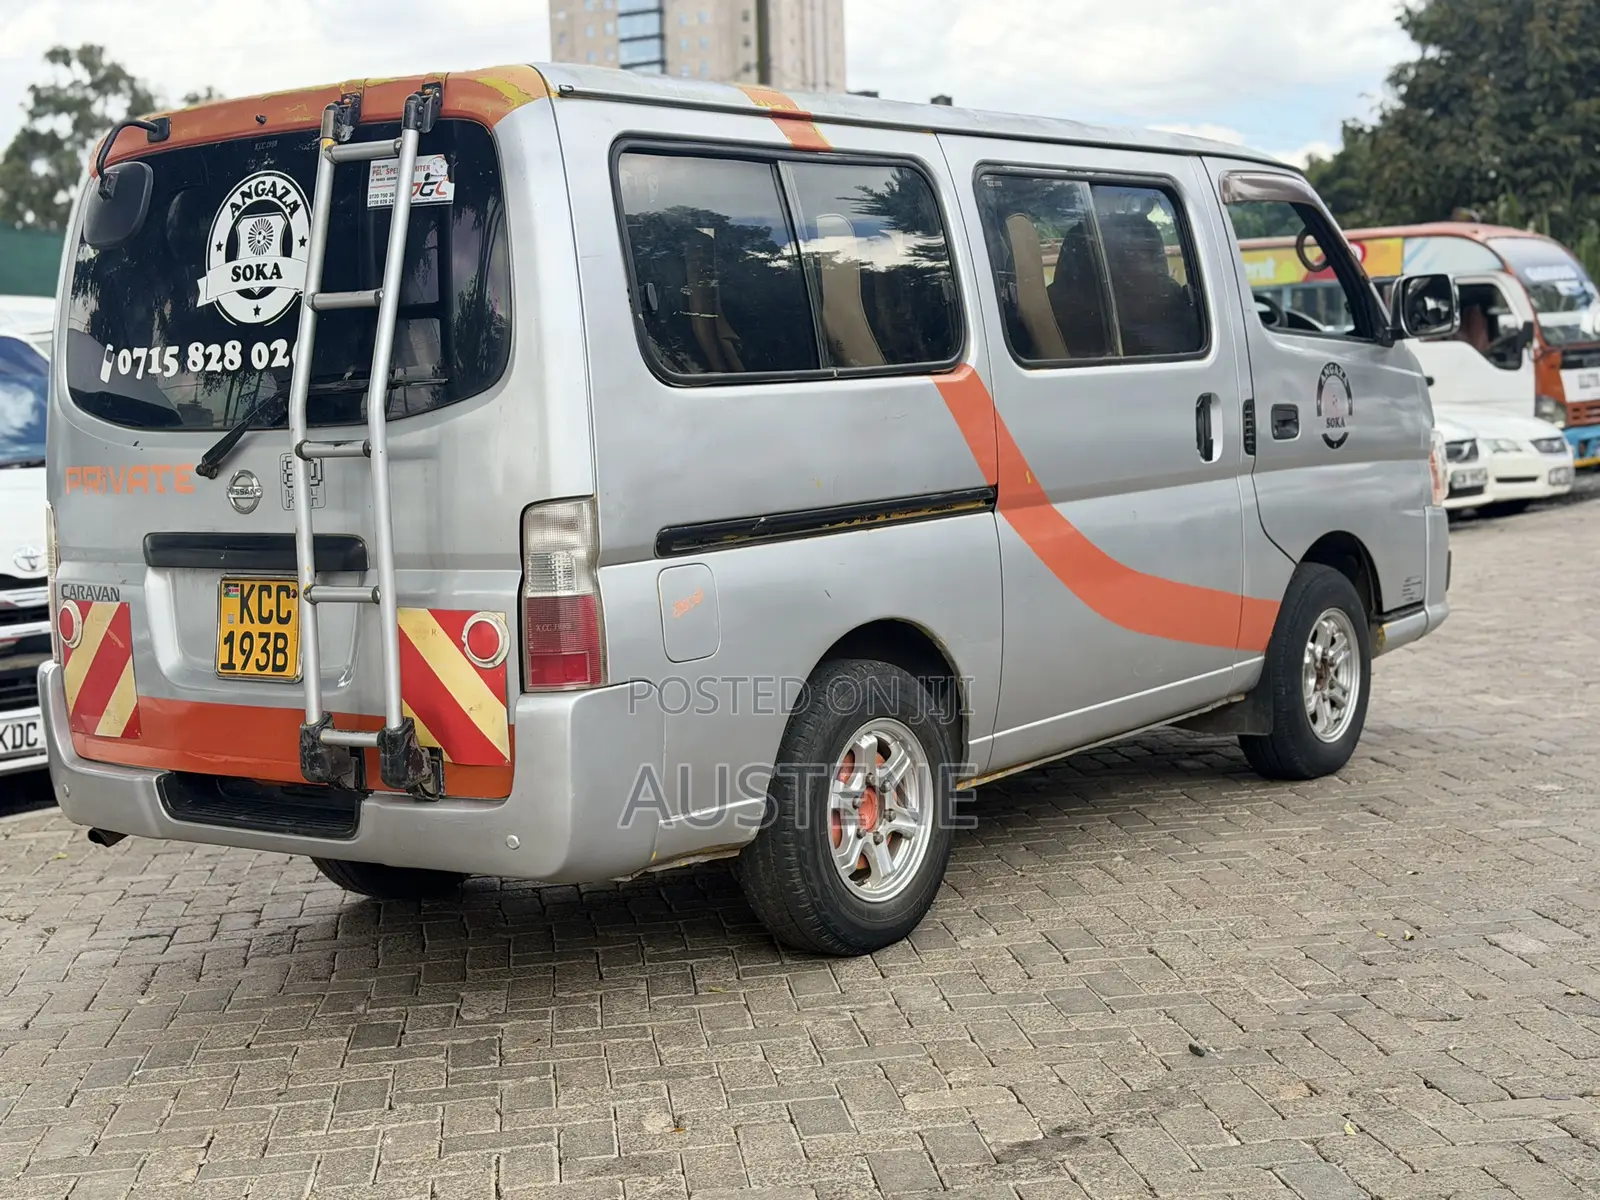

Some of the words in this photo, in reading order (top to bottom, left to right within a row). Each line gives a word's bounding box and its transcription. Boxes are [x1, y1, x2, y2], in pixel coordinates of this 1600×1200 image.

[229, 180, 301, 219] ANGAZA
[231, 262, 283, 282] SOKA
[117, 347, 180, 377] 0715
[187, 340, 242, 372] 828
[251, 338, 298, 370] 02
[1326, 416, 1345, 428] SOKA
[229, 487, 258, 497] NISSAN
[61, 584, 120, 602] CARAVAN
[240, 584, 292, 625] KCC
[221, 631, 289, 672] 193B
[0, 722, 38, 751] KDC
